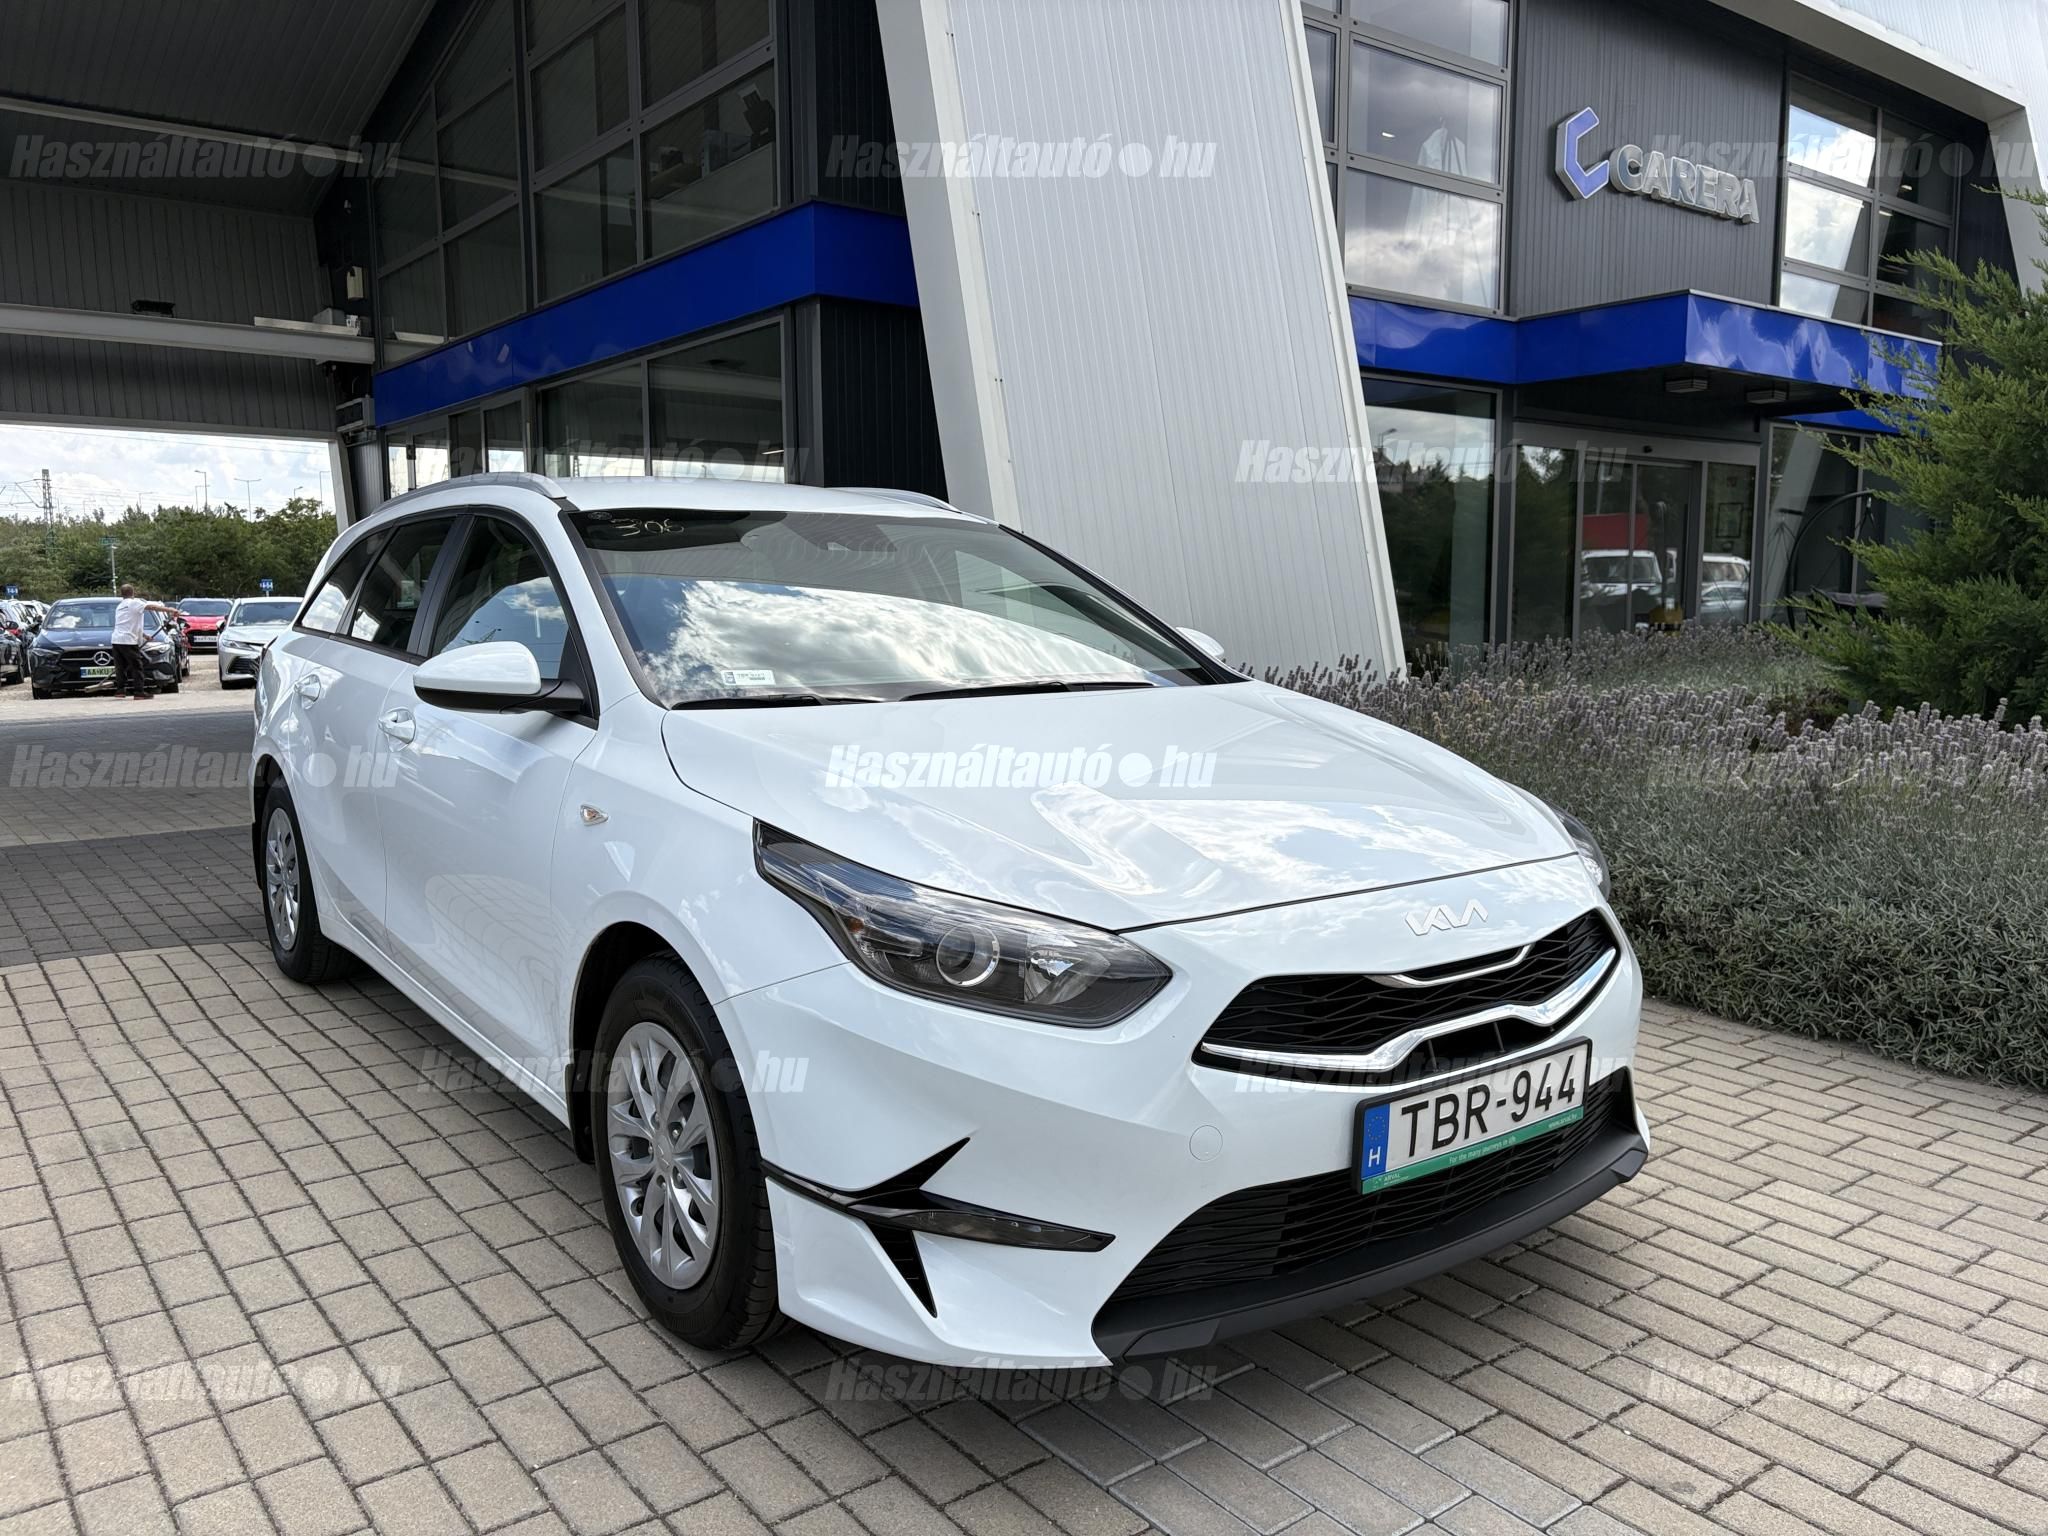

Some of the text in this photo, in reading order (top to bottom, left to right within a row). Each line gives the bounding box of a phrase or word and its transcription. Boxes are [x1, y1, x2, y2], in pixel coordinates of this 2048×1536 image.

[1610, 144, 1760, 214] CARERA
[1405, 899, 1488, 936] KIA
[1401, 1054, 1576, 1157] TBR-944
[1368, 1146, 1381, 1168] H
